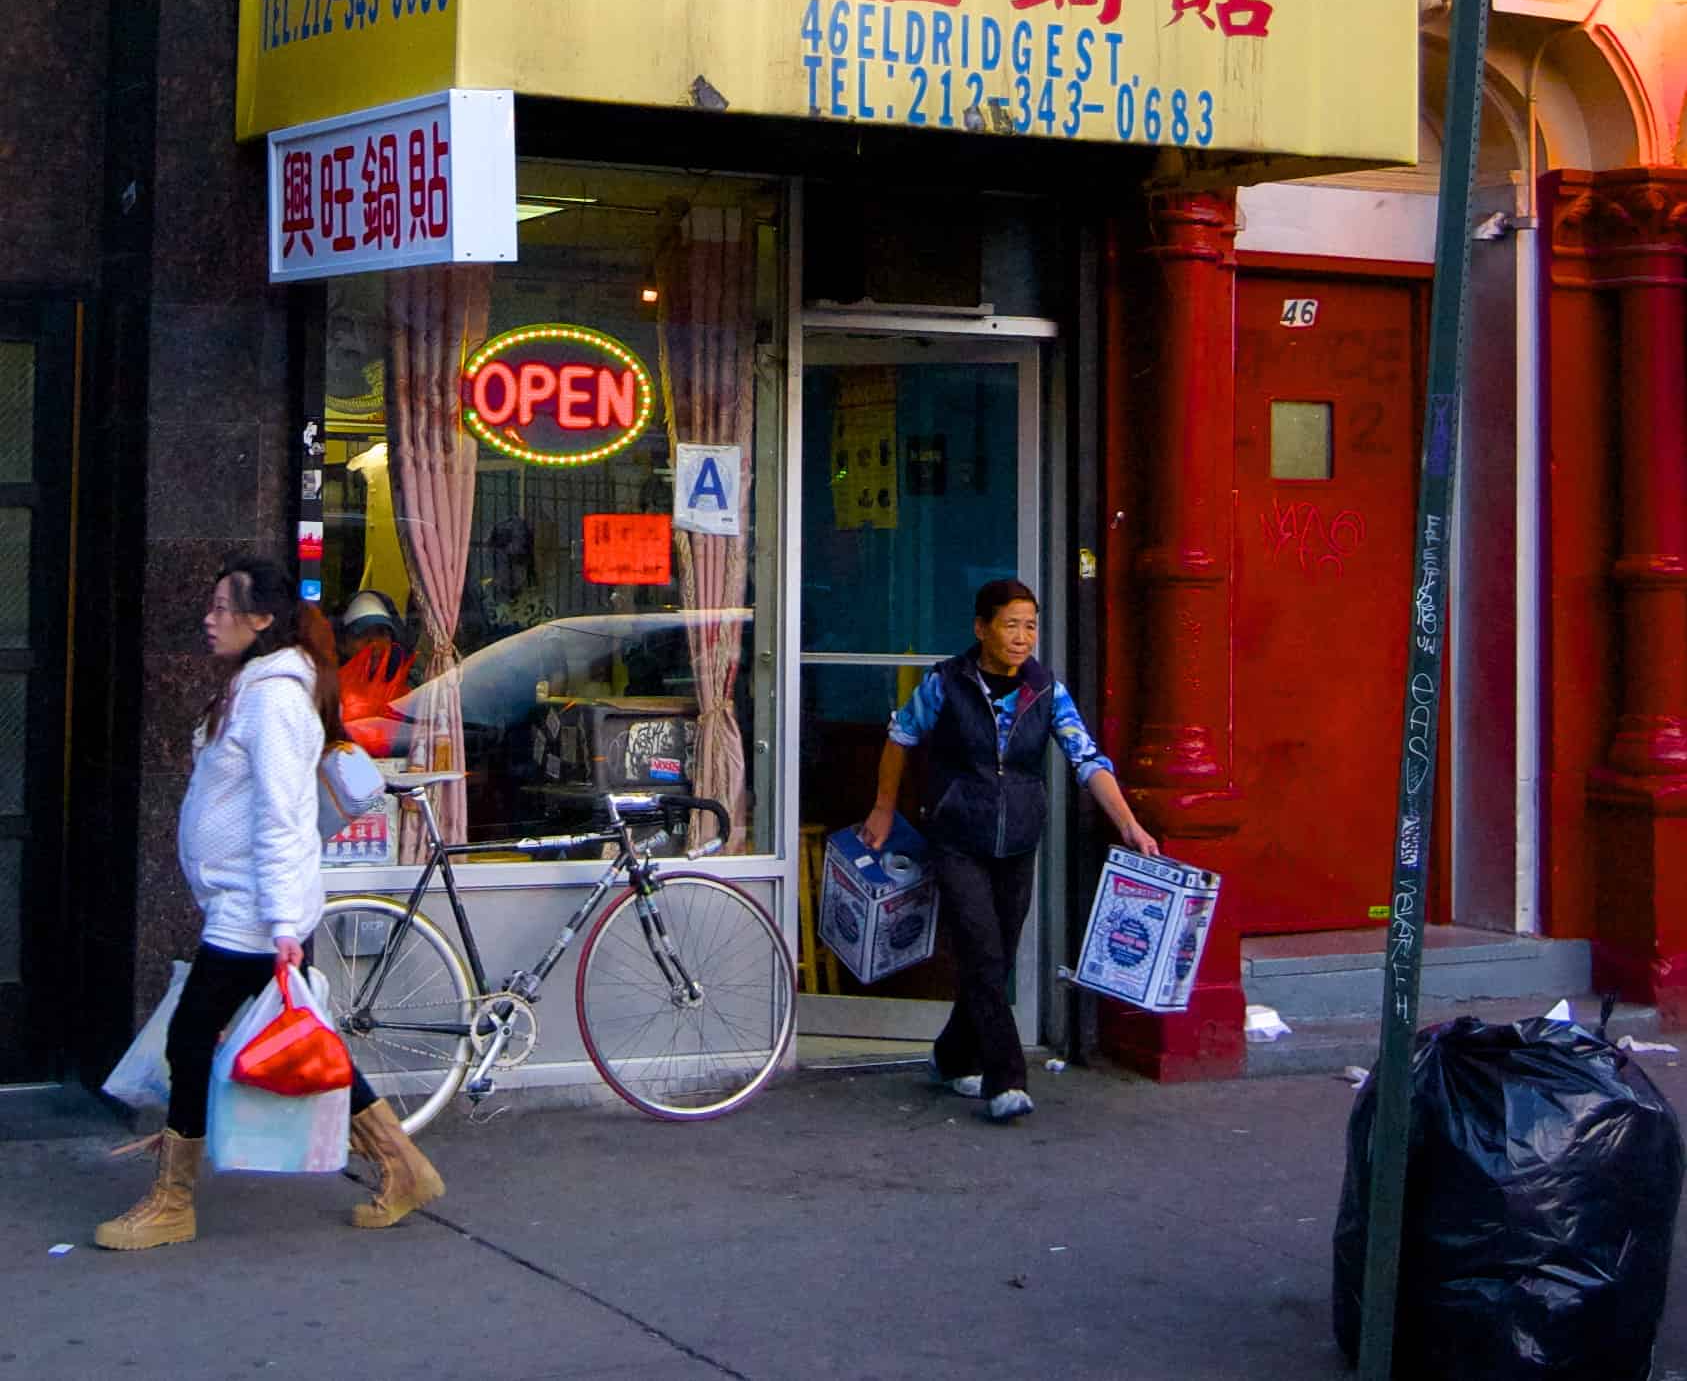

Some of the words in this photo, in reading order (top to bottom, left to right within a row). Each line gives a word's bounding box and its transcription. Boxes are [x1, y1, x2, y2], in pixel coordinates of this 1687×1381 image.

[282, 121, 449, 258] 興旺鍋貼
[1281, 300, 1316, 324] 46
[473, 361, 635, 430] OPEN
[687, 457, 728, 510] A
